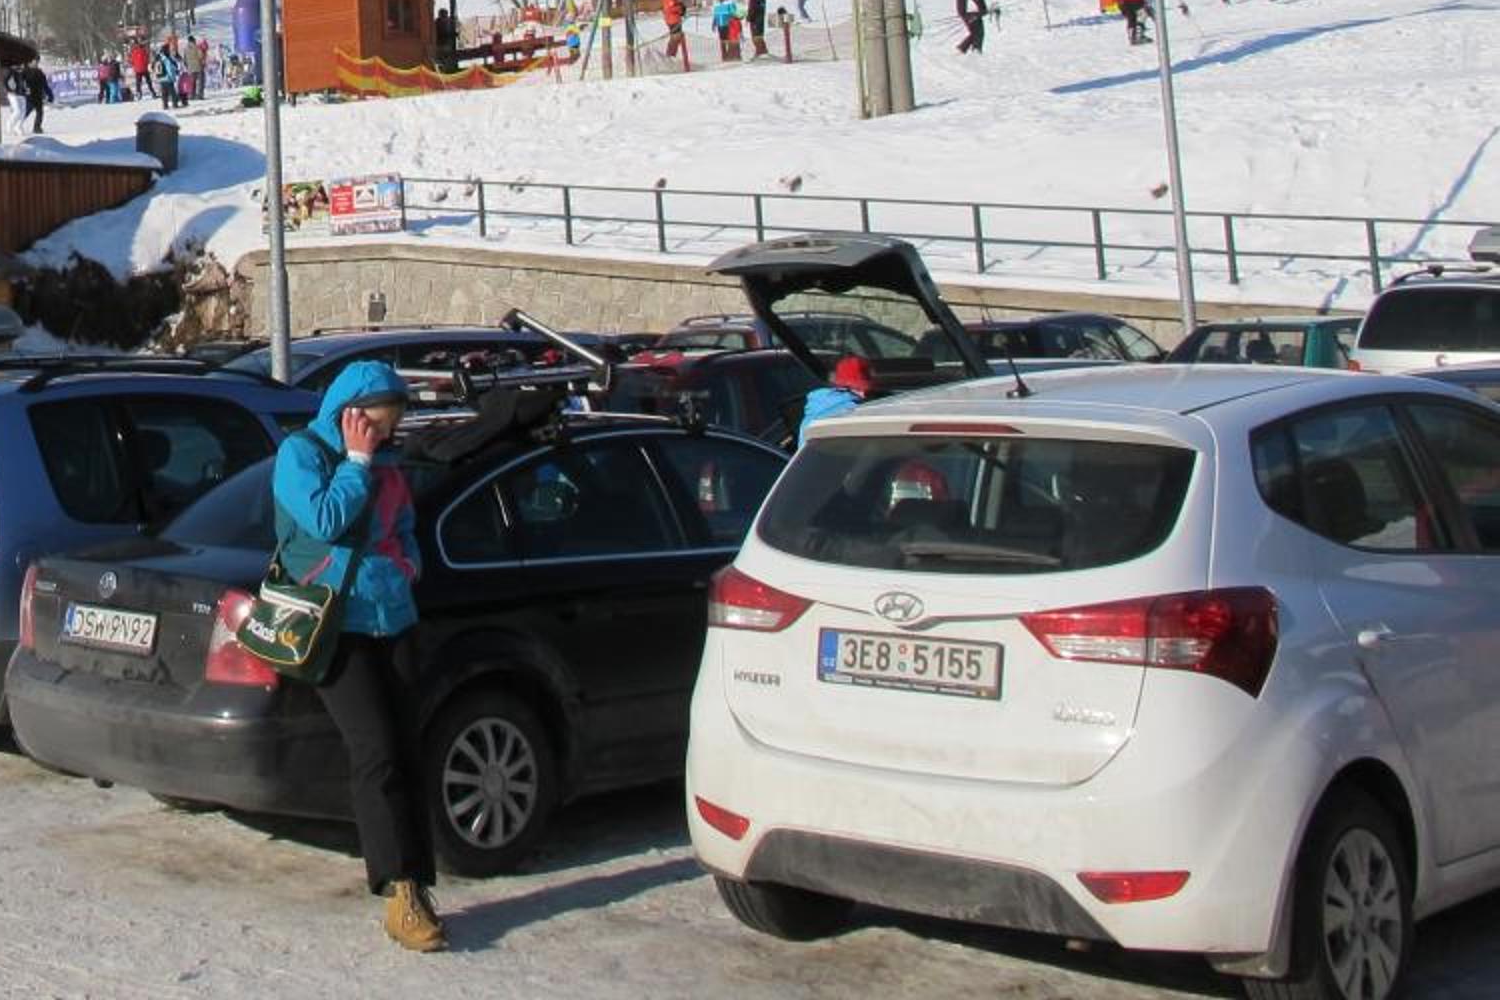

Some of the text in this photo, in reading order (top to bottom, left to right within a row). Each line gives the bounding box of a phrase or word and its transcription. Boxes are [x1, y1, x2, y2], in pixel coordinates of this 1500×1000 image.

[109, 614, 152, 645] 9N92
[843, 638, 983, 682] 3E8 5155
